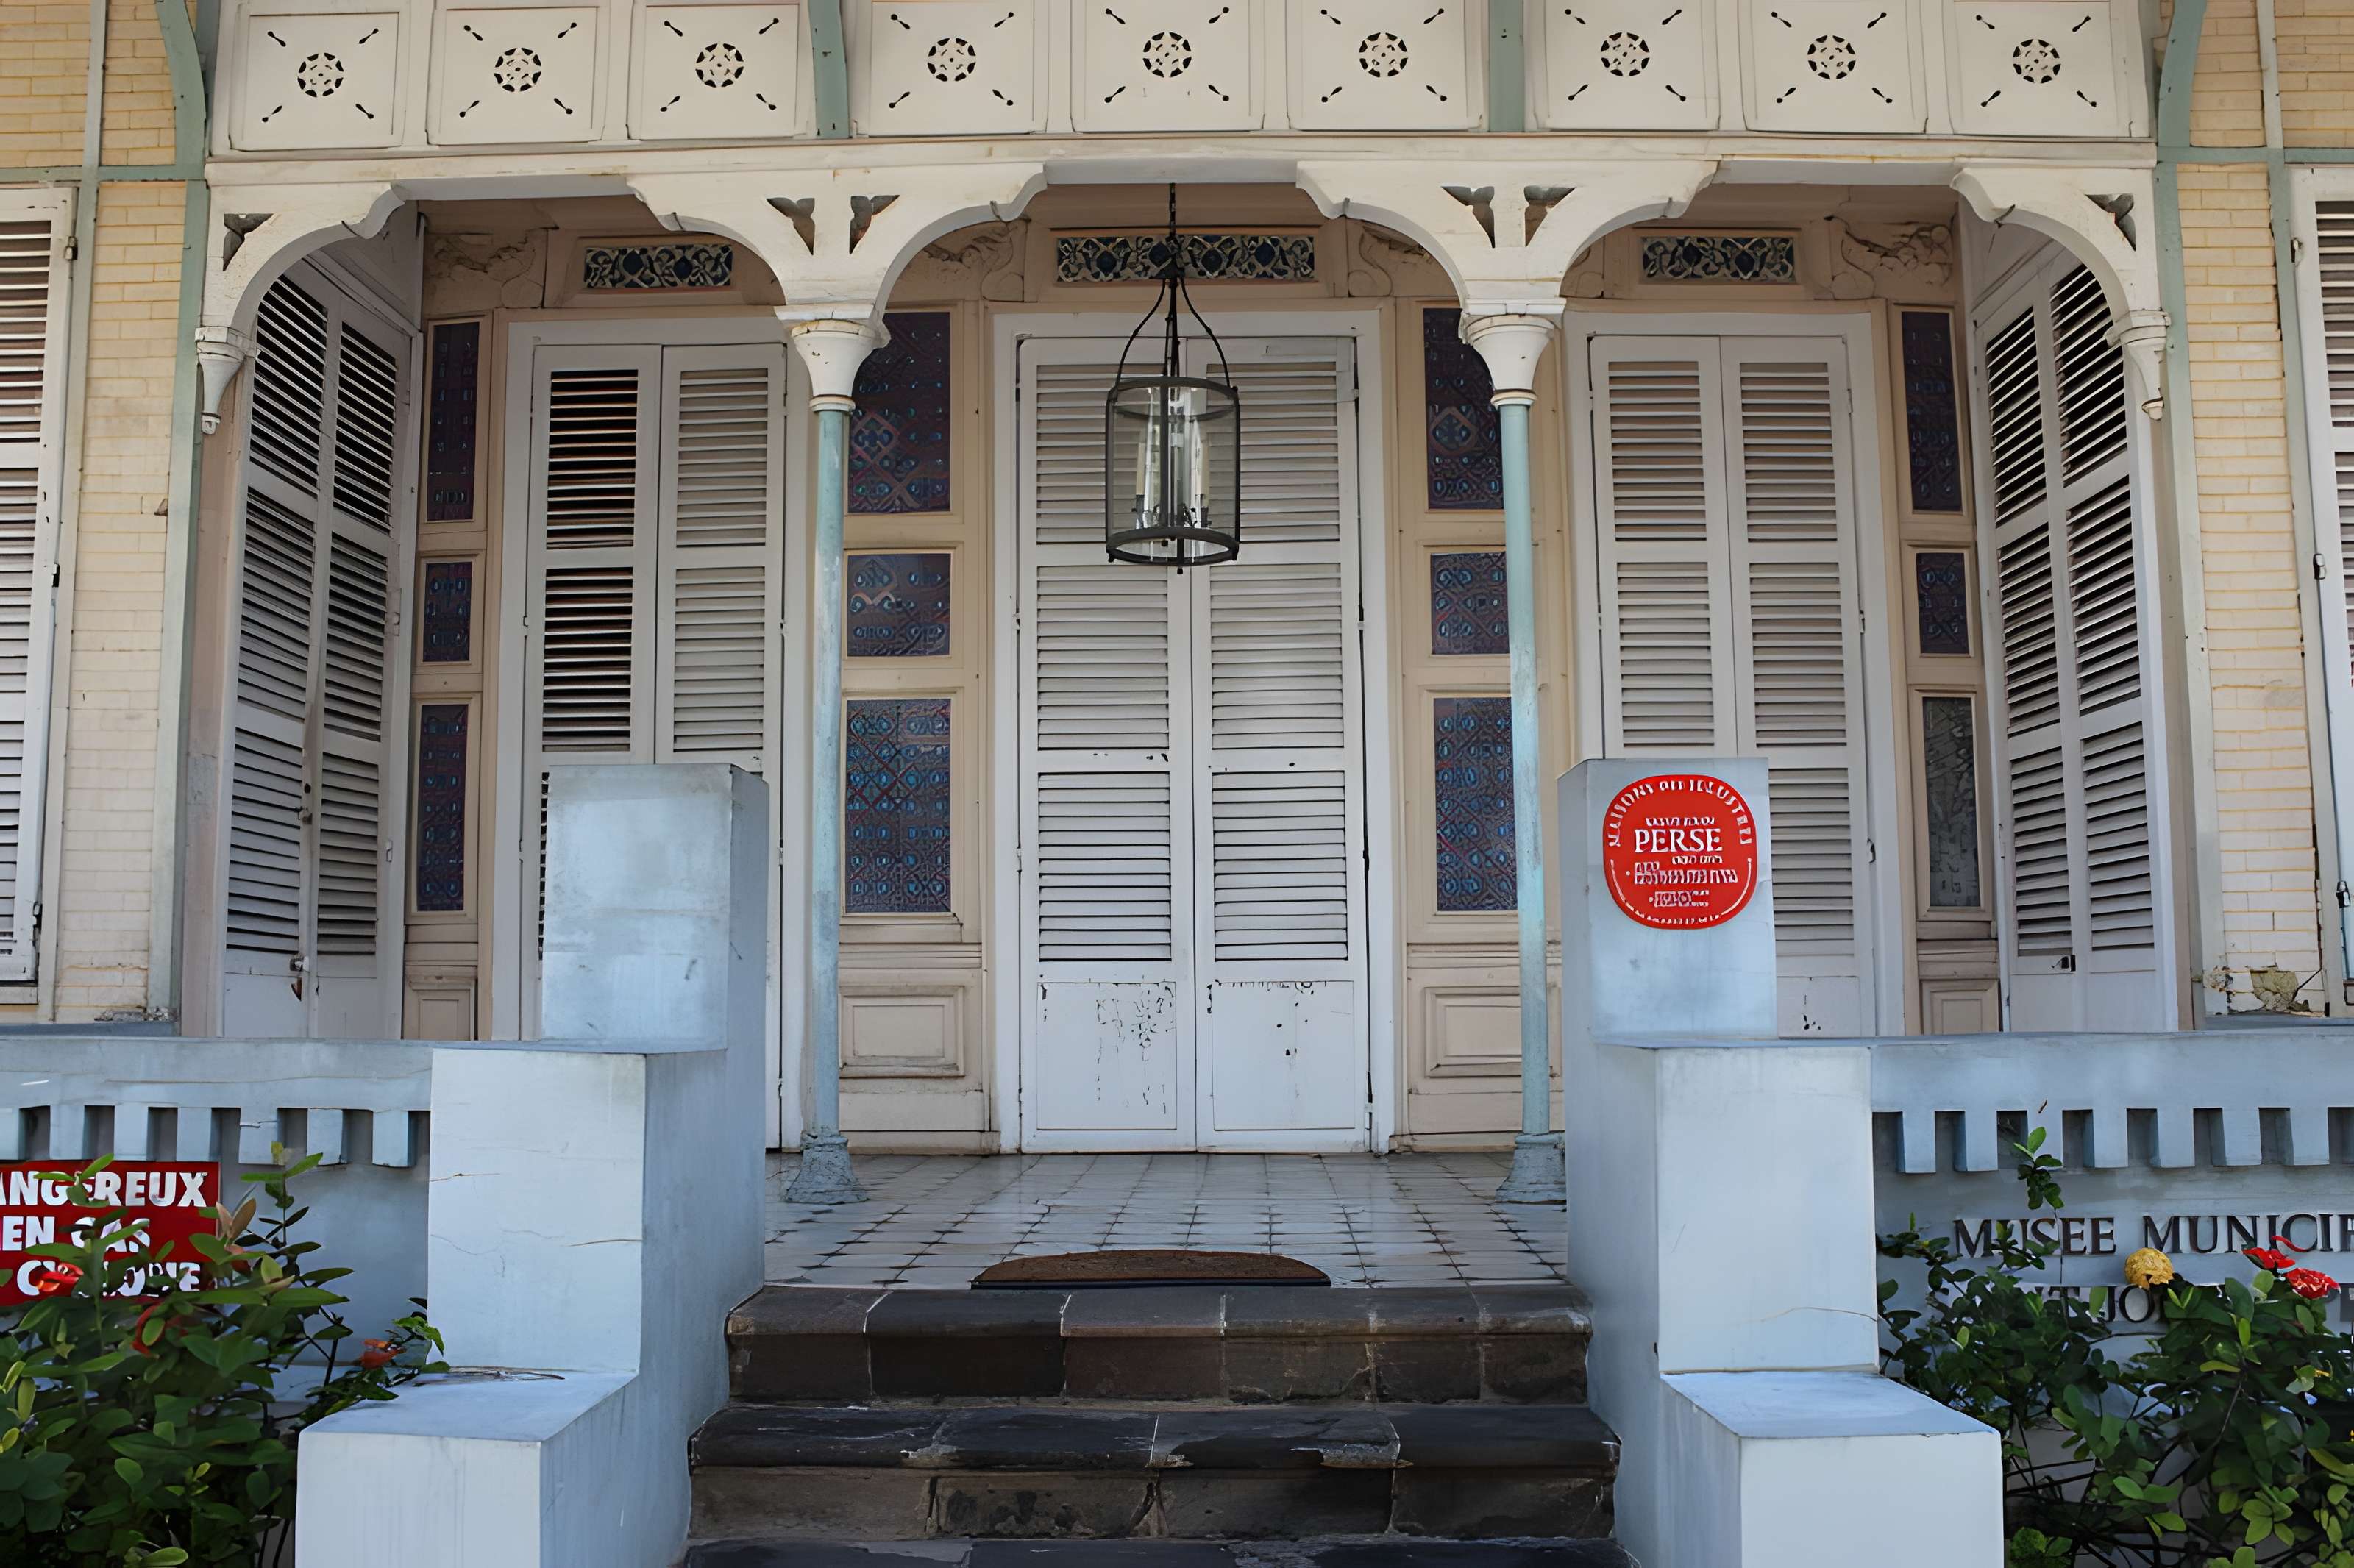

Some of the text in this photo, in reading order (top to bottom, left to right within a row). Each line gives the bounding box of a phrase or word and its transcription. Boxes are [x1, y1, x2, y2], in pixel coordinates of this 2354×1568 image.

[1635, 828, 1723, 853] PERSE
[0, 1171, 207, 1208] NGREUX
[2, 1216, 55, 1252] EN
